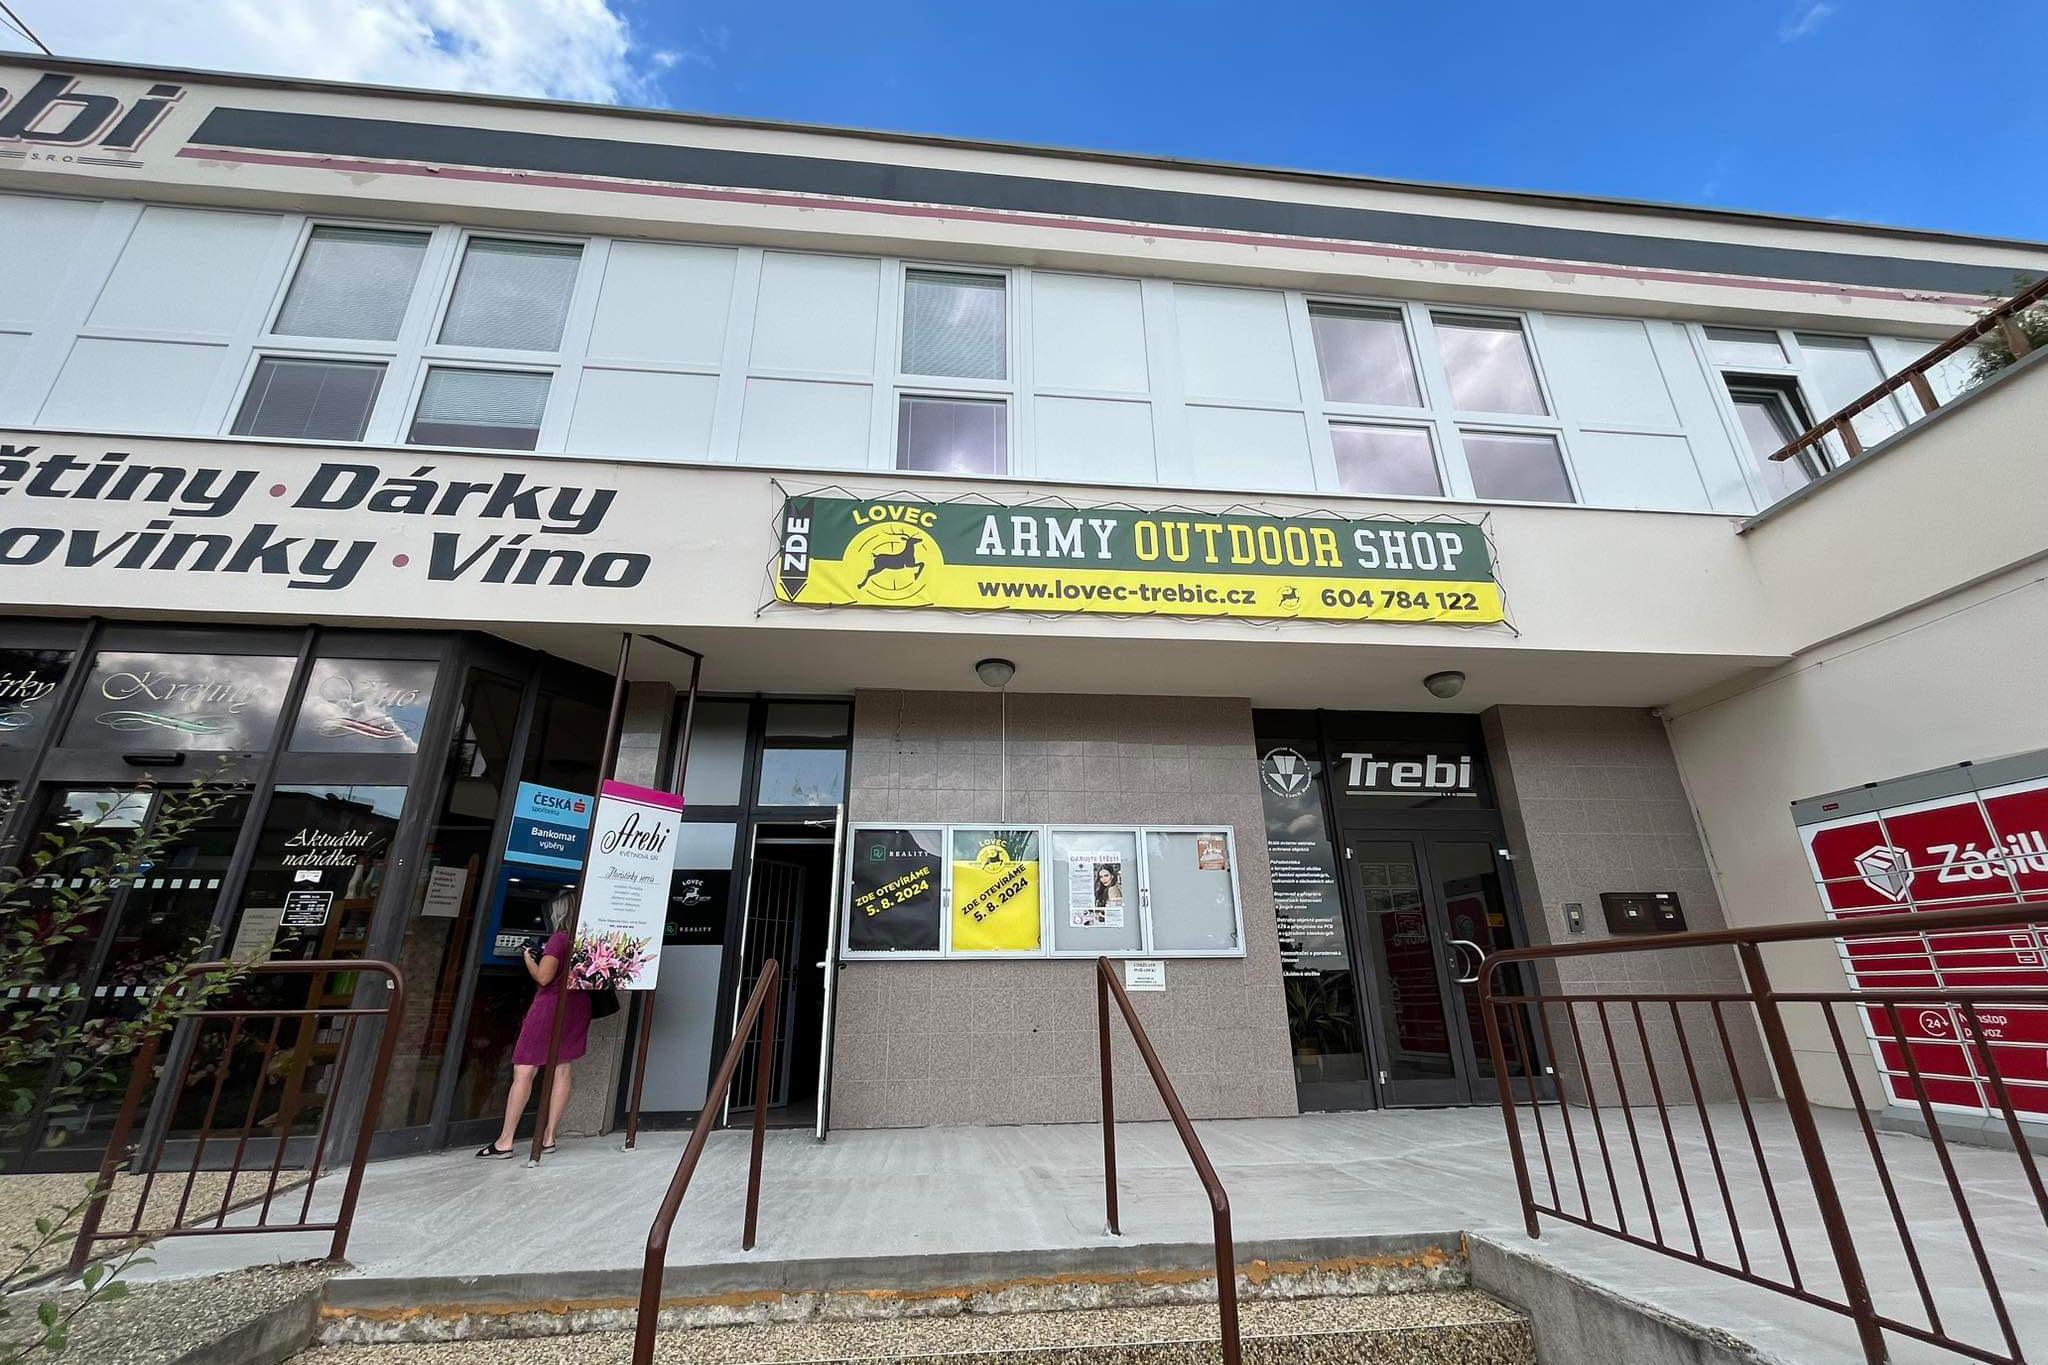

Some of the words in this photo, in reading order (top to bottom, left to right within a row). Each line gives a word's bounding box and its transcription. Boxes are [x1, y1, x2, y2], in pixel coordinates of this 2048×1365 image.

[291, 462, 618, 535] Dárky
[852, 504, 938, 528] LOVEC
[784, 517, 810, 572] ZDE
[975, 515, 1118, 560] ARMY
[1134, 520, 1343, 568] OUTDOOR
[1353, 528, 1464, 571] SHOP
[427, 531, 652, 589] Víno
[977, 579, 1256, 606] www.lovec-trebic.cz
[1321, 588, 1375, 609] 604
[1380, 590, 1430, 610] 784
[1435, 591, 1480, 612] 122
[1341, 752, 1471, 788] Trebi
[533, 791, 571, 811] ČESKÁ
[284, 827, 373, 847] Aktuální
[531, 826, 577, 842] Bankomat
[540, 841, 565, 852] výběry
[600, 812, 671, 854] Arebi
[978, 838, 1008, 848] LOVEC
[682, 879, 705, 887] LOVEC
[855, 892, 876, 907] ZDE
[875, 866, 931, 897] OTEVÍRÁME
[865, 904, 880, 917] 5.
[880, 897, 895, 910] 8.
[895, 879, 930, 903] 2024
[961, 898, 981, 916] ZDE
[979, 863, 1027, 902] OTEVÍRÁME
[973, 910, 987, 922] 5.
[986, 901, 1000, 913] 8.
[998, 877, 1029, 904] 2024
[1925, 1018, 1942, 1029] 24
